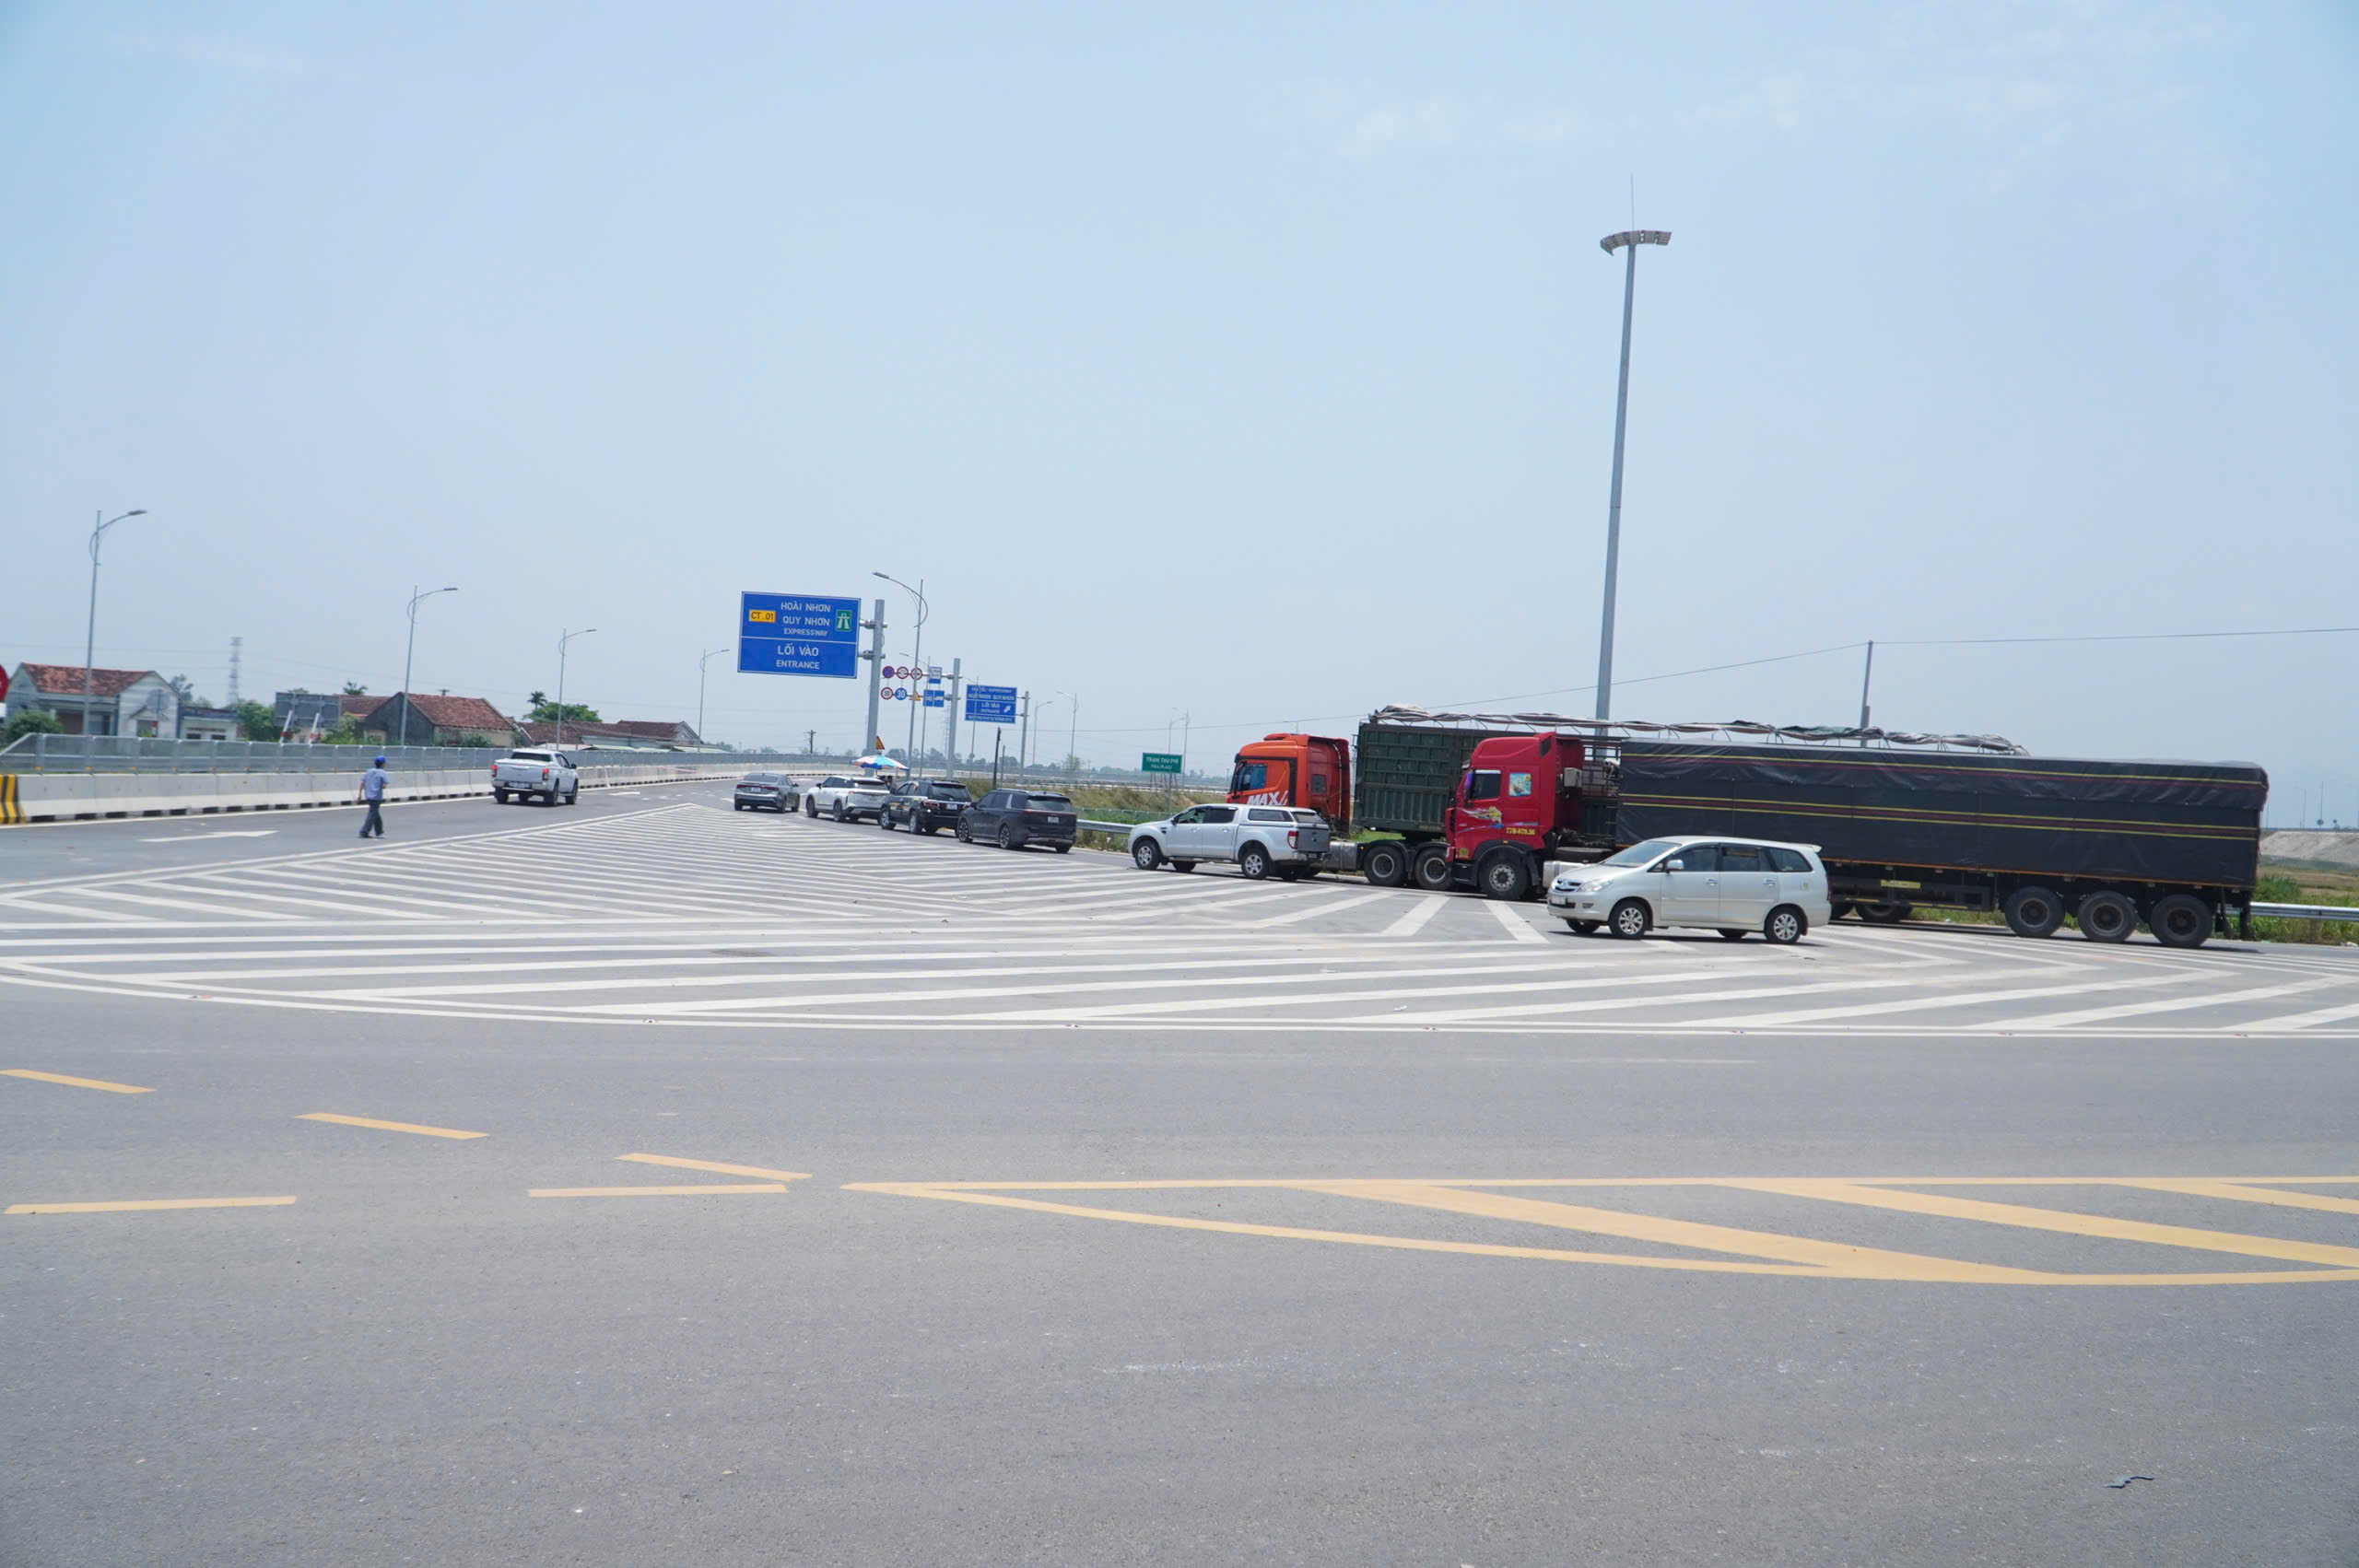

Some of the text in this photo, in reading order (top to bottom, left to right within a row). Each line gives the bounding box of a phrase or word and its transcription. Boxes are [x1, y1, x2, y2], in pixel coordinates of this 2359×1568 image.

[780, 601, 830, 613] HOÀI NHƠN
[782, 615, 830, 626] QUY NHƠN
[783, 627, 828, 637] EXPRESSWAY
[799, 645, 819, 657] VÀO
[776, 660, 820, 670] ENTRANCE
[897, 690, 906, 698] 30
